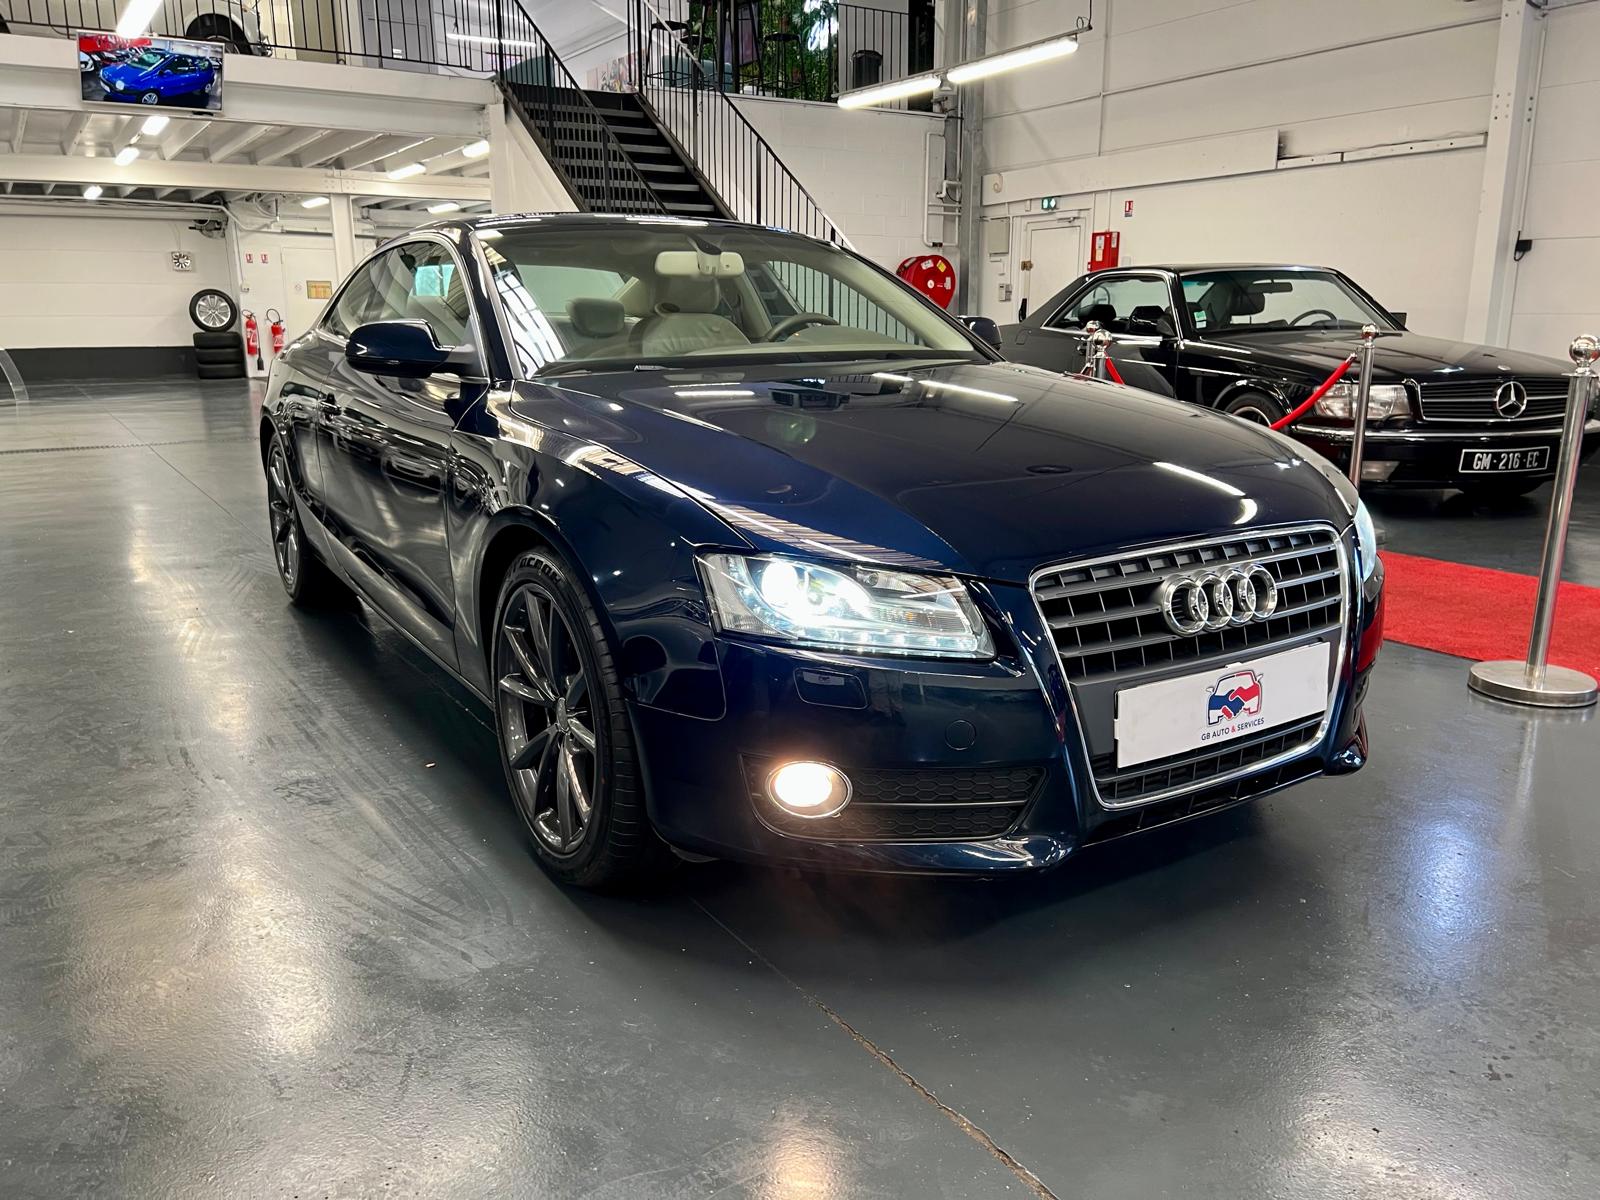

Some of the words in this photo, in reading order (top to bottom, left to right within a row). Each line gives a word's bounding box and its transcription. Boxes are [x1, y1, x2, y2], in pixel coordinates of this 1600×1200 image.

[1201, 732, 1211, 741] GB
[1212, 727, 1230, 738] AUTO
[1237, 717, 1265, 732] SERVICES
